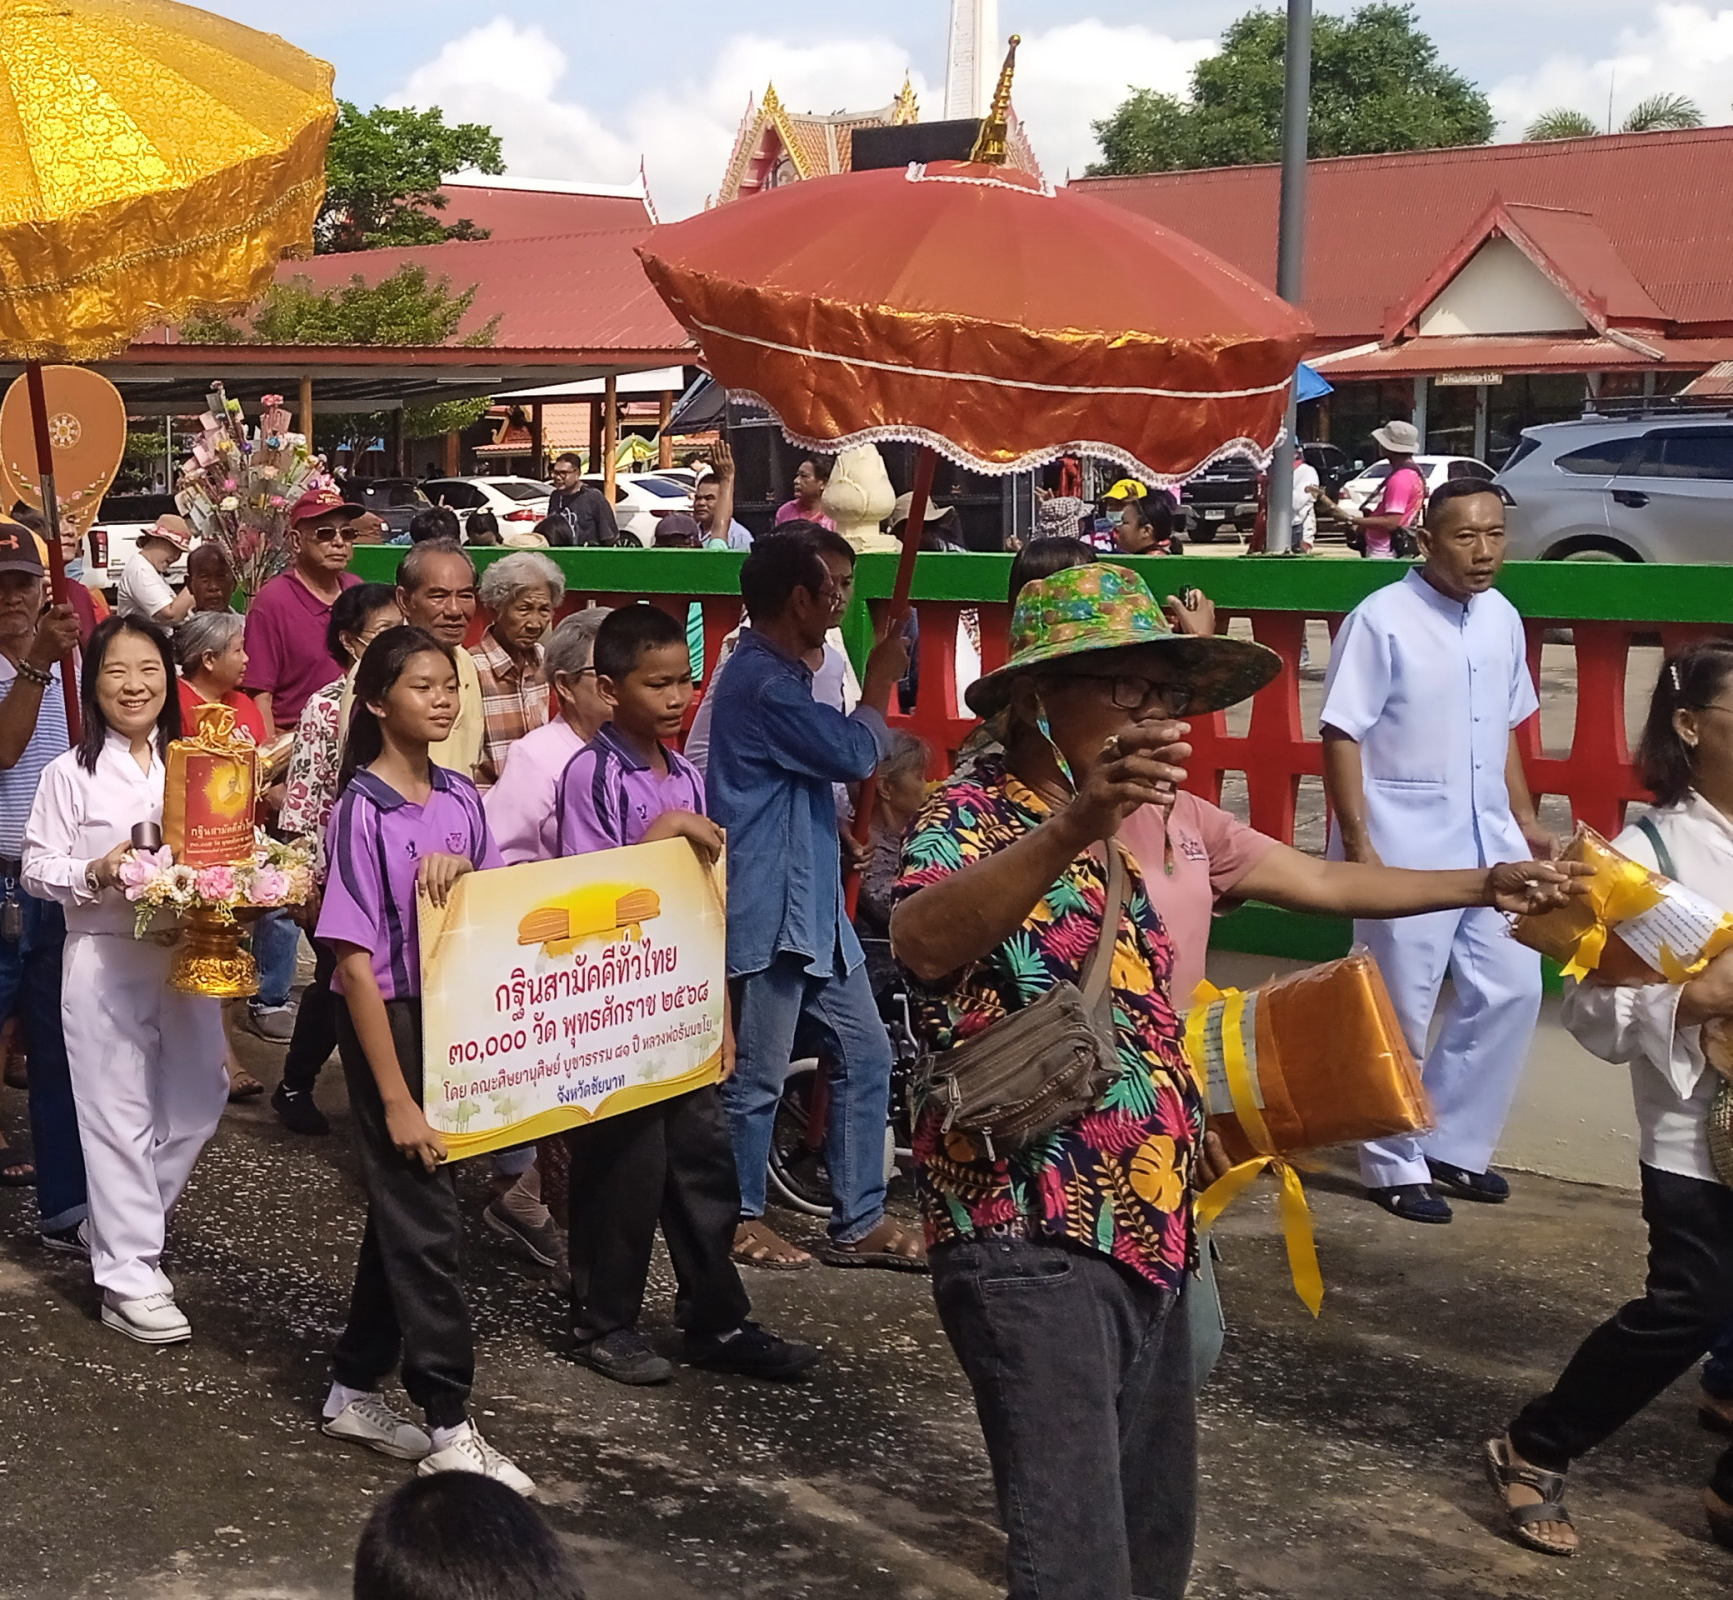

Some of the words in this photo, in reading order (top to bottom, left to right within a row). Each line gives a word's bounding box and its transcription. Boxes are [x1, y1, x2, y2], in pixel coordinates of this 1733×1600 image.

[495, 933, 678, 1021] กฐินสามัคคีทั่วไทย
[443, 1080, 467, 1102] โดย
[470, 1053, 561, 1096] คณะศิษยานุศิษย์
[563, 1048, 613, 1078] บูชาธรรม
[632, 1033, 641, 1054] ปี
[643, 1014, 713, 1050] หลวงพ่อธัมมชโย
[449, 1030, 527, 1065] ๓๐,๐๐๐
[533, 1011, 557, 1045] วัด
[562, 995, 657, 1048] พุทธศักราช
[662, 980, 710, 1012] ๒๕๖๘
[557, 1073, 626, 1103] จังหวัดชัยนาท
